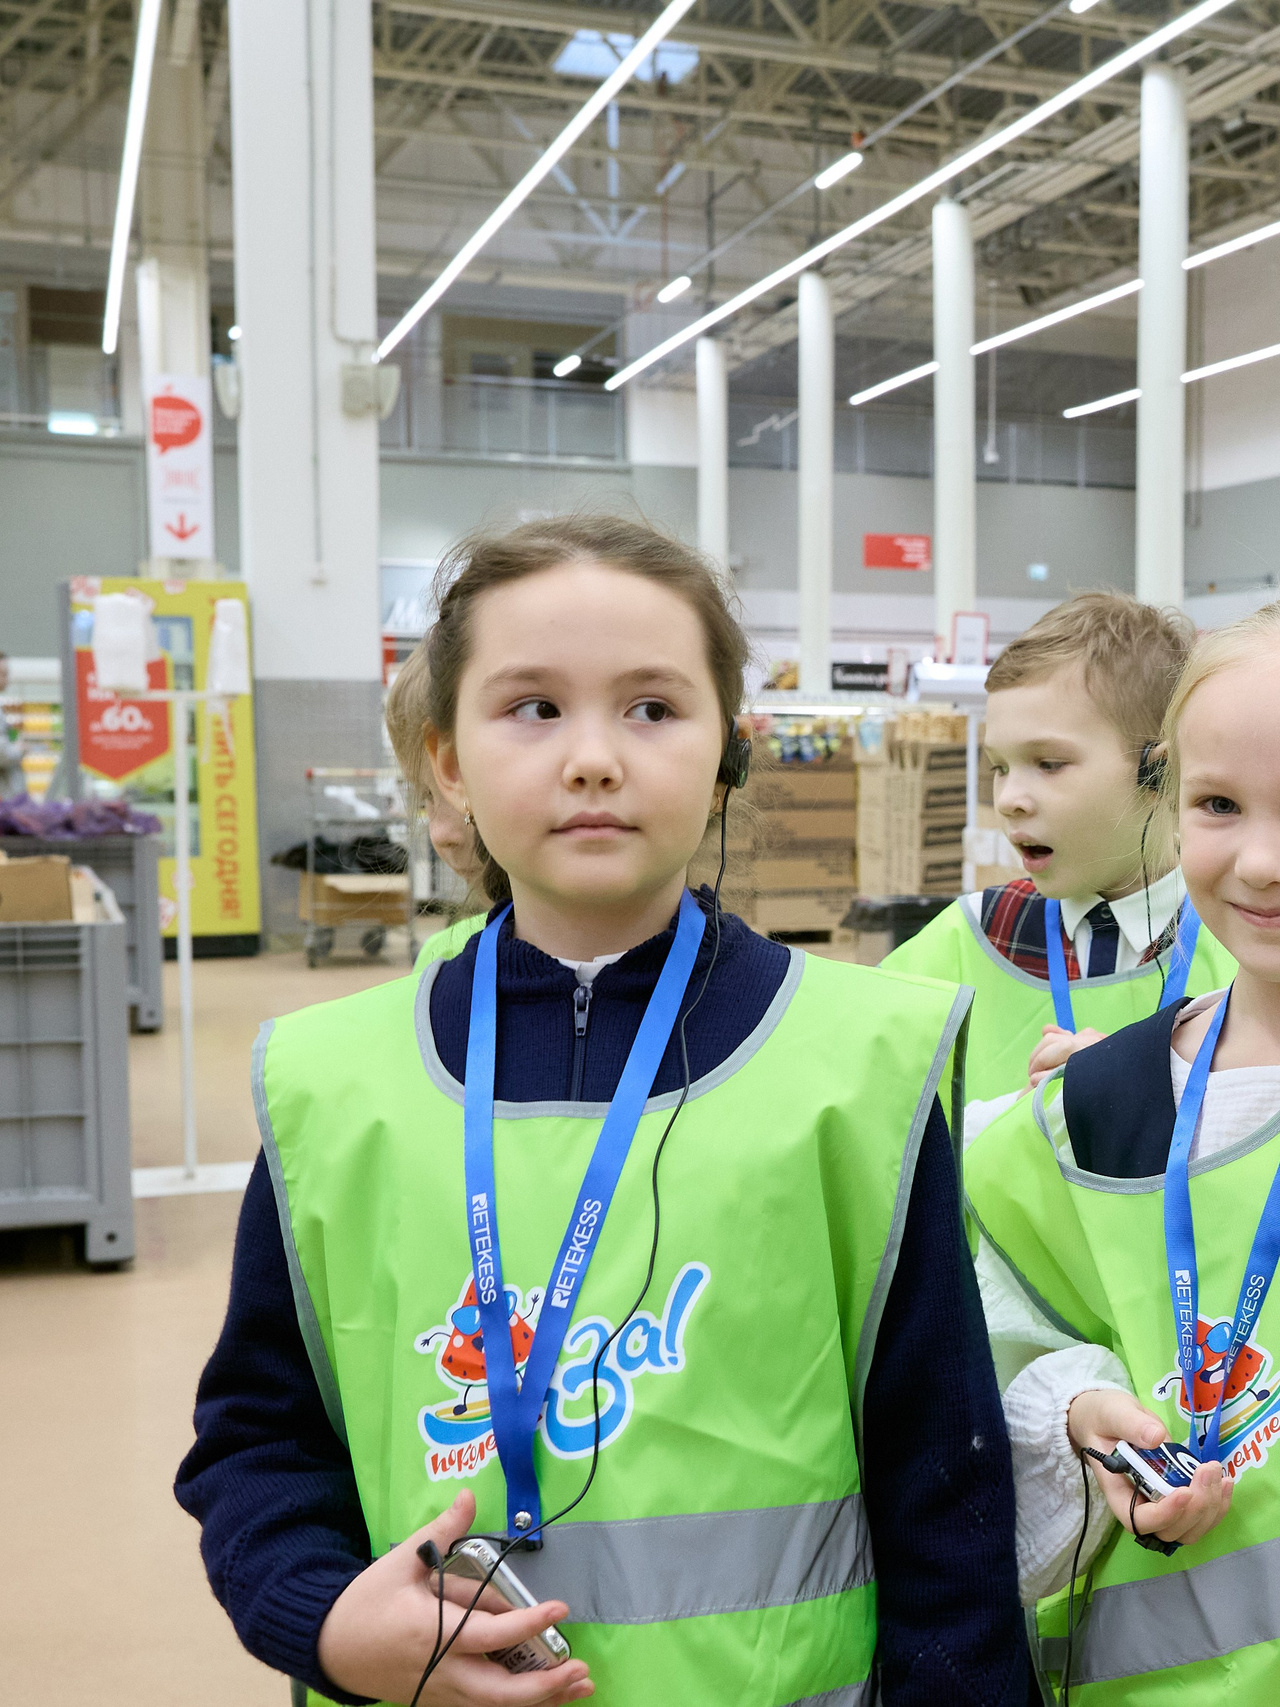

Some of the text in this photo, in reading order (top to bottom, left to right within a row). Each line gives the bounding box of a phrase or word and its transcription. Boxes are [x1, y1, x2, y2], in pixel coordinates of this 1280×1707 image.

[472, 1193, 497, 1305] RETEKESS
[551, 1199, 601, 1308] RETEKESS
[1175, 1269, 1193, 1371] RETEKESS
[430, 1433, 498, 1475] поколе
